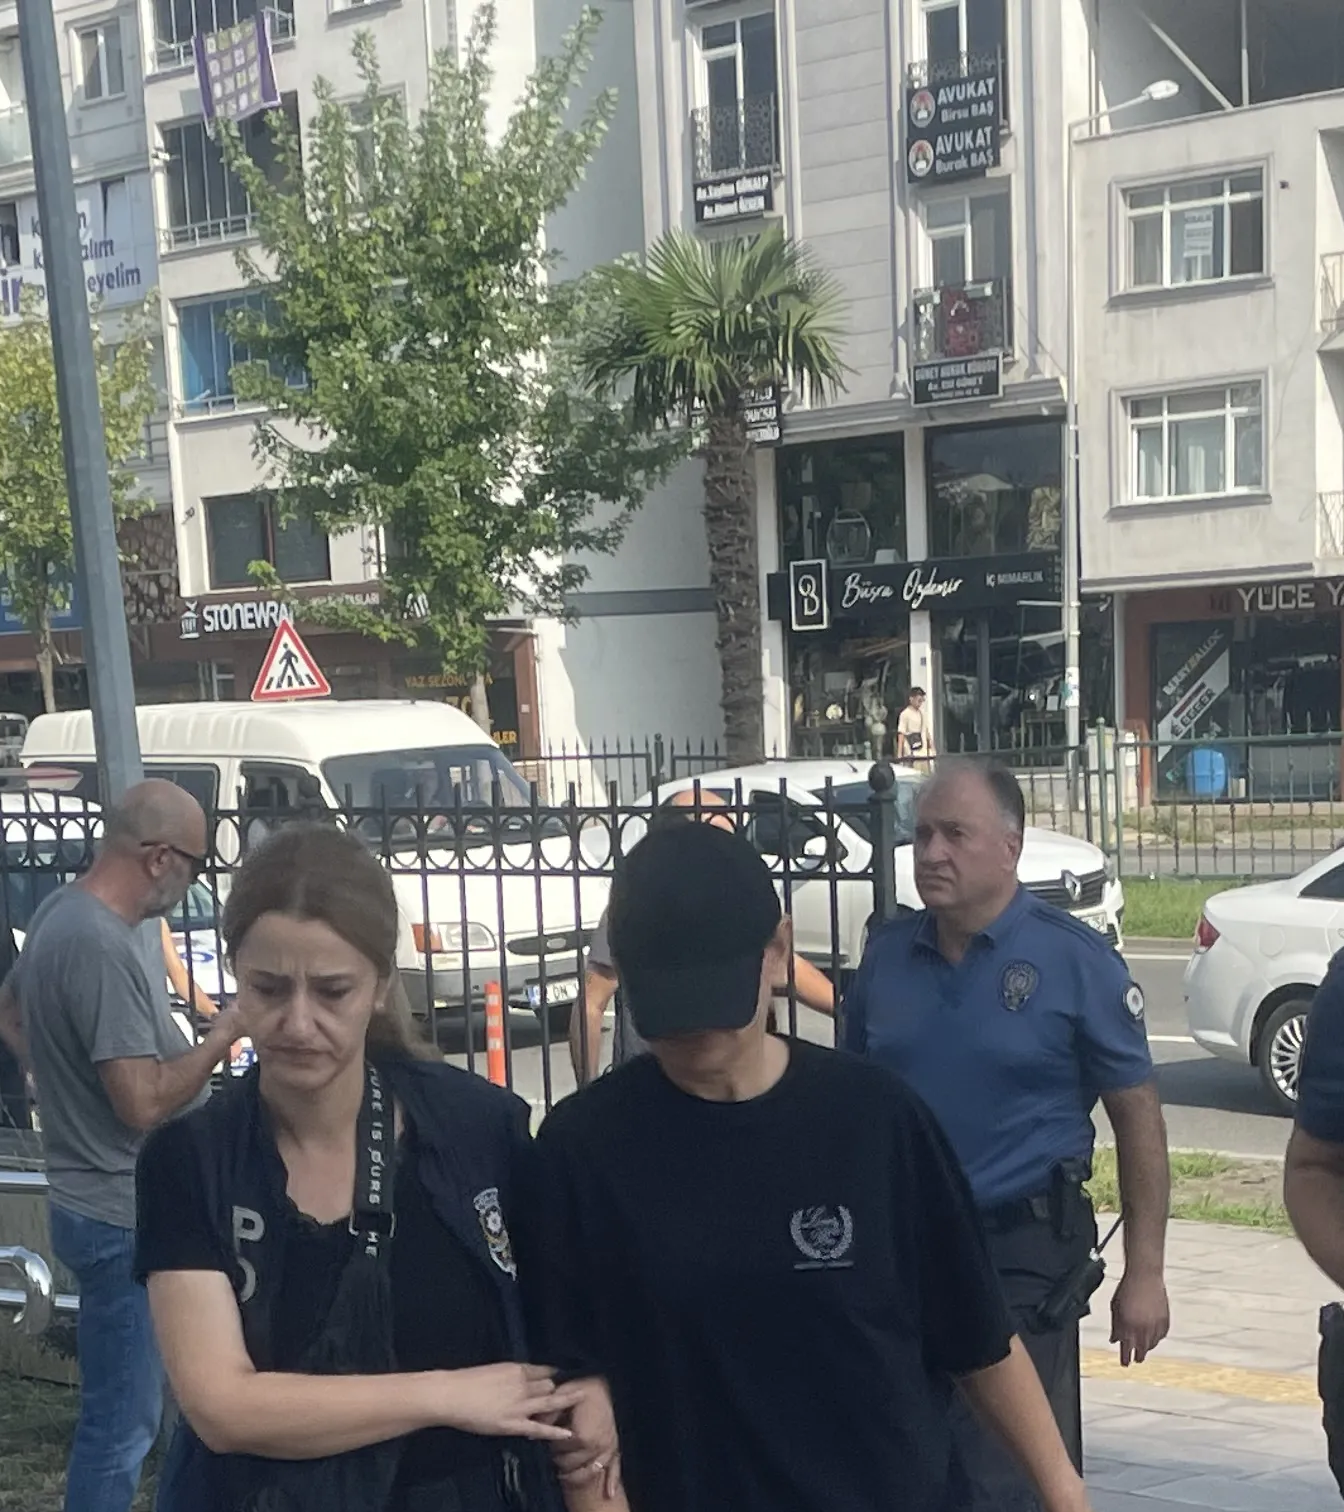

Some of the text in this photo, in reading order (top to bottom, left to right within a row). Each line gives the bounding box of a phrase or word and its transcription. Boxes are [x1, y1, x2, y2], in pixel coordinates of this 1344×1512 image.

[937, 77, 996, 105] AVUKAT
[936, 126, 993, 155] AVUKAT
[1237, 583, 1316, 612] YÜCE
